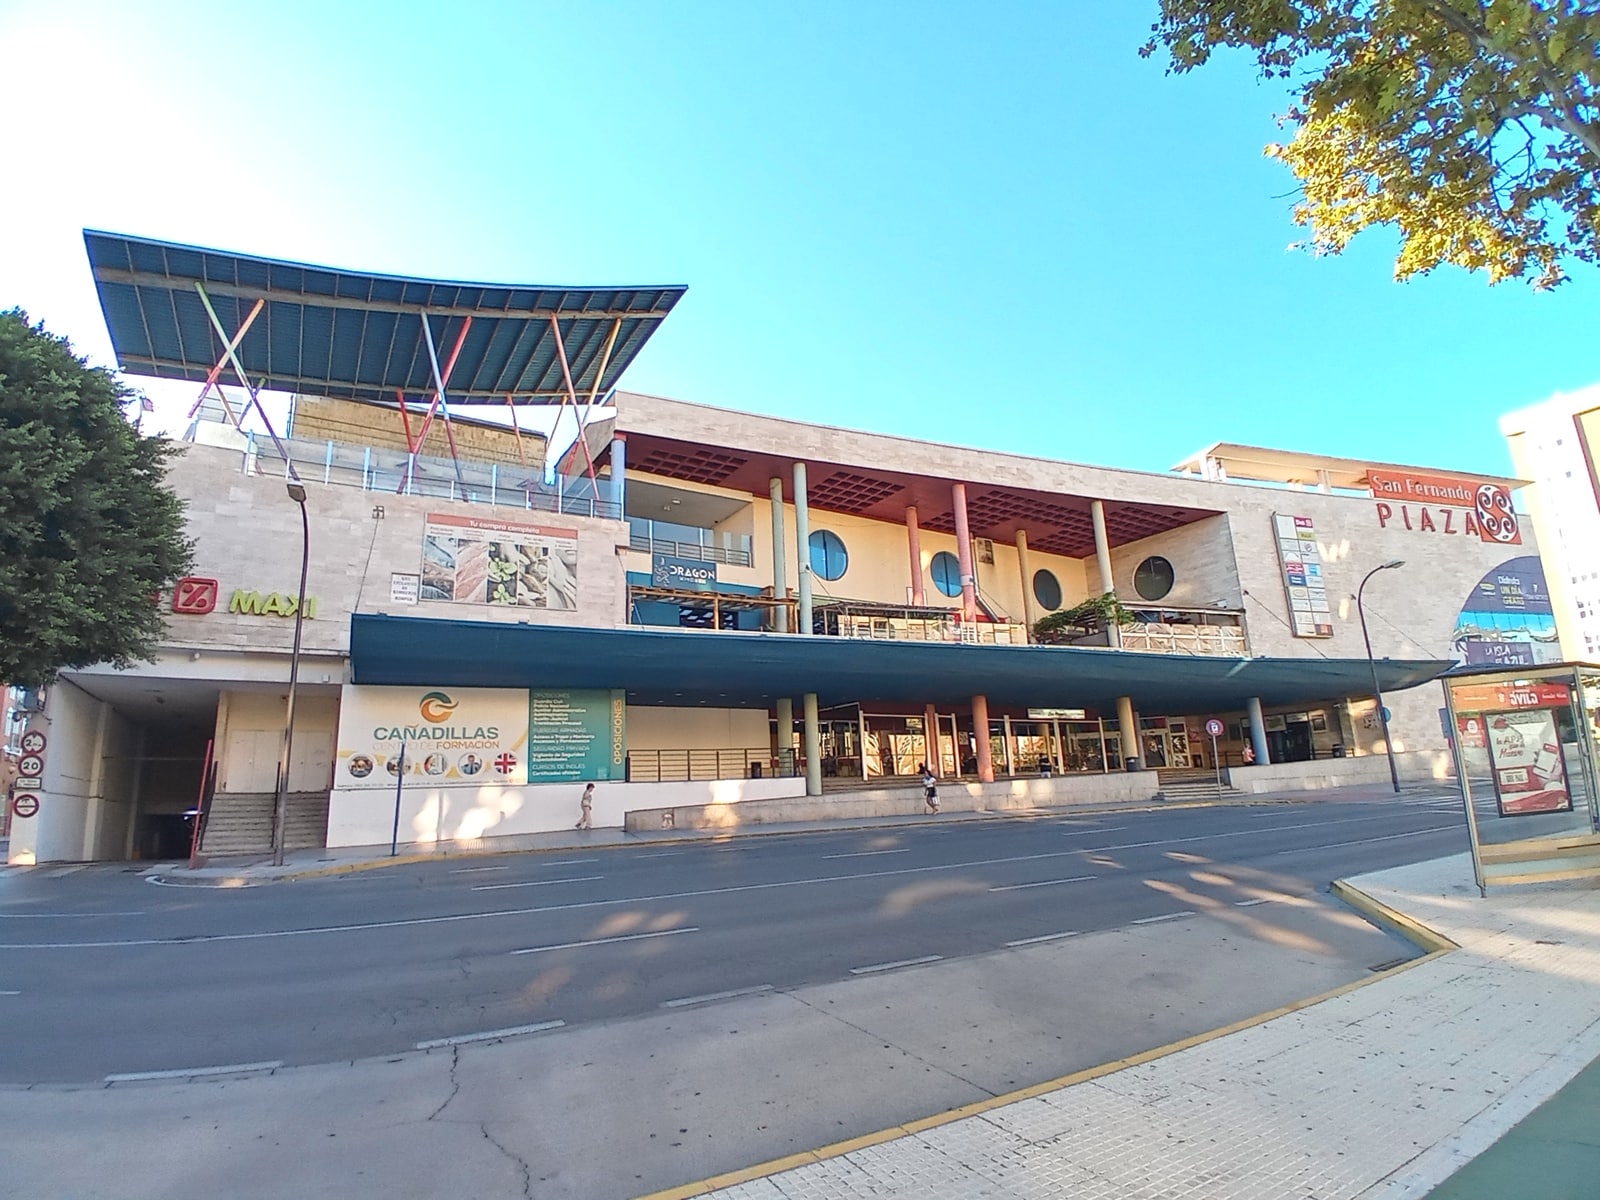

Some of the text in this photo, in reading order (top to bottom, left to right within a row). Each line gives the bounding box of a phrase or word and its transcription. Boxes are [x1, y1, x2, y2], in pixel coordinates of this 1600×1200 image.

[1372, 475, 1472, 501] San Fernando
[1376, 503, 1479, 536] PLAZA
[669, 565, 715, 579] DRAGON
[229, 588, 318, 619] MAXI
[373, 724, 499, 741] CAÑADILLAS
[613, 698, 623, 765] OPOSICIONES
[436, 739, 500, 750] FORMACIÓN
[23, 761, 39, 770] 20
